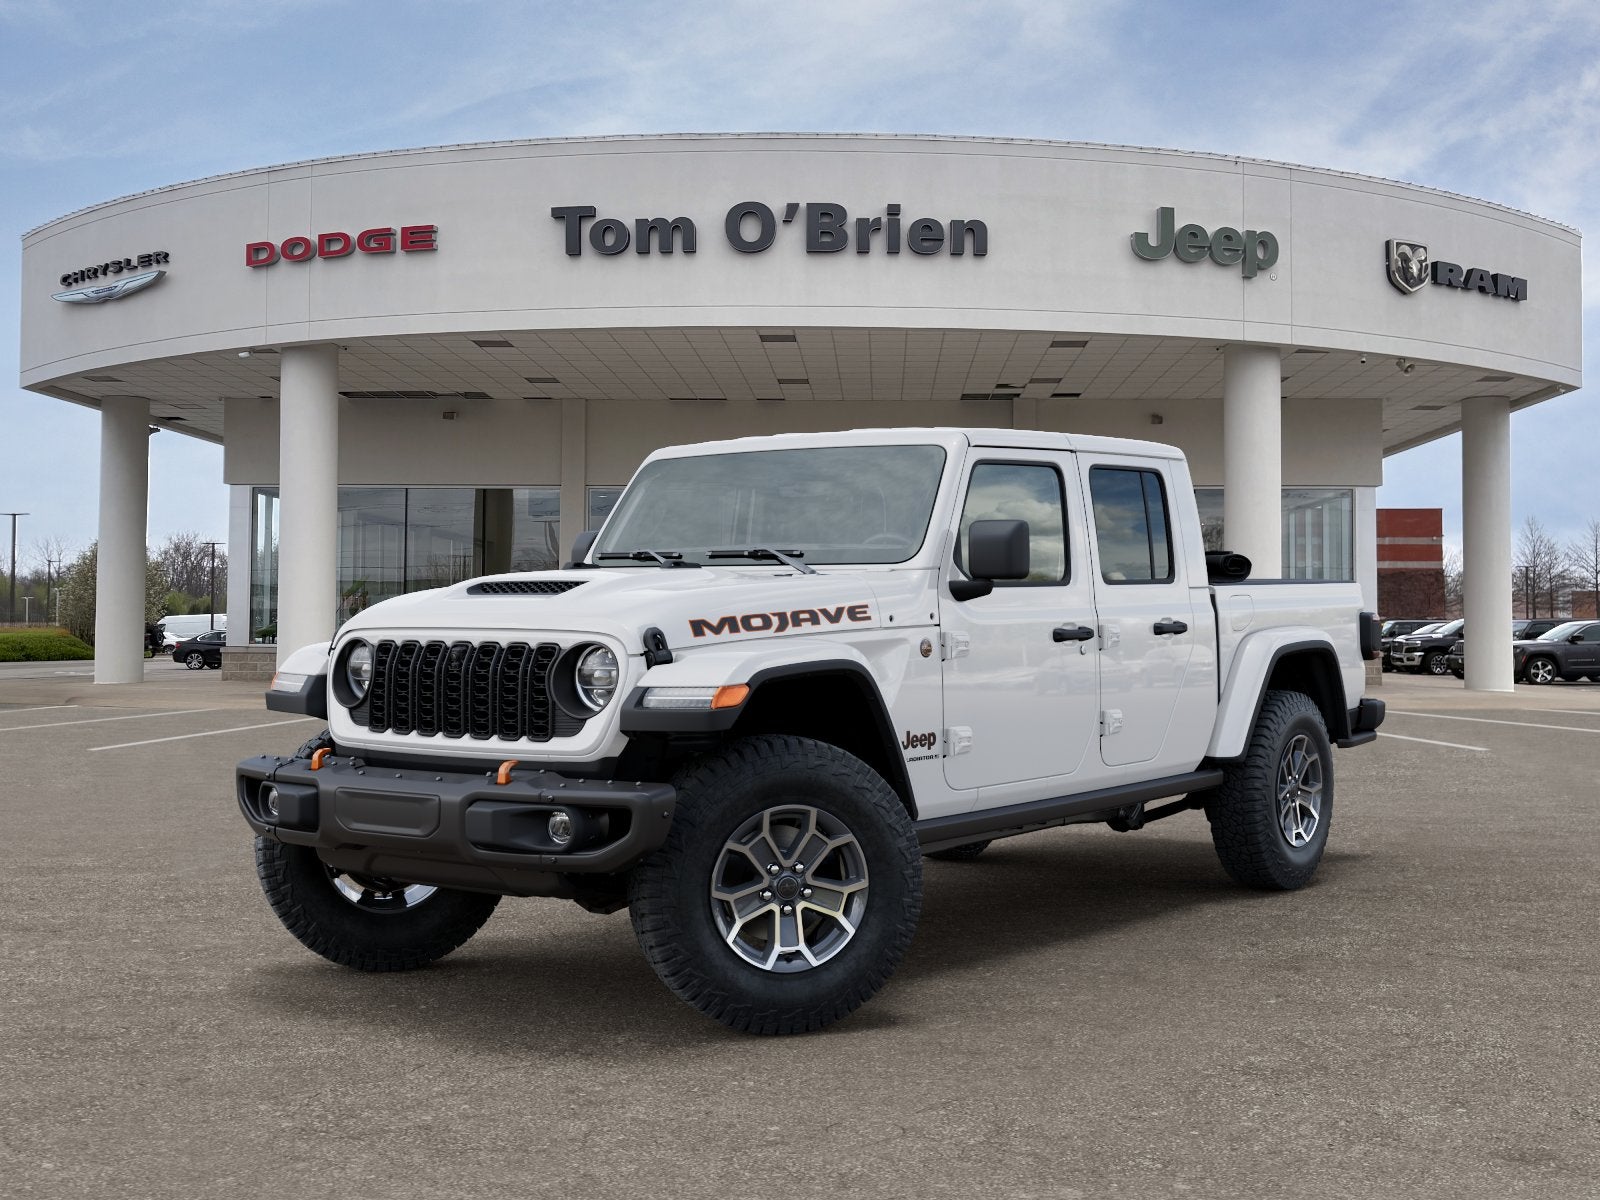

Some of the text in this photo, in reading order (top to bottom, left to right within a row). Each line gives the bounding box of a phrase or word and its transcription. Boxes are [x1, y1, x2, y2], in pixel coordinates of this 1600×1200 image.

[246, 224, 437, 268] DODGE
[551, 201, 988, 256] Tom O'Brien
[1130, 206, 1279, 278] Jeep
[60, 251, 170, 286] CHRYSLER
[1431, 261, 1527, 301] RAM
[688, 603, 872, 638] MOJAVE
[901, 730, 937, 750] Jeep
